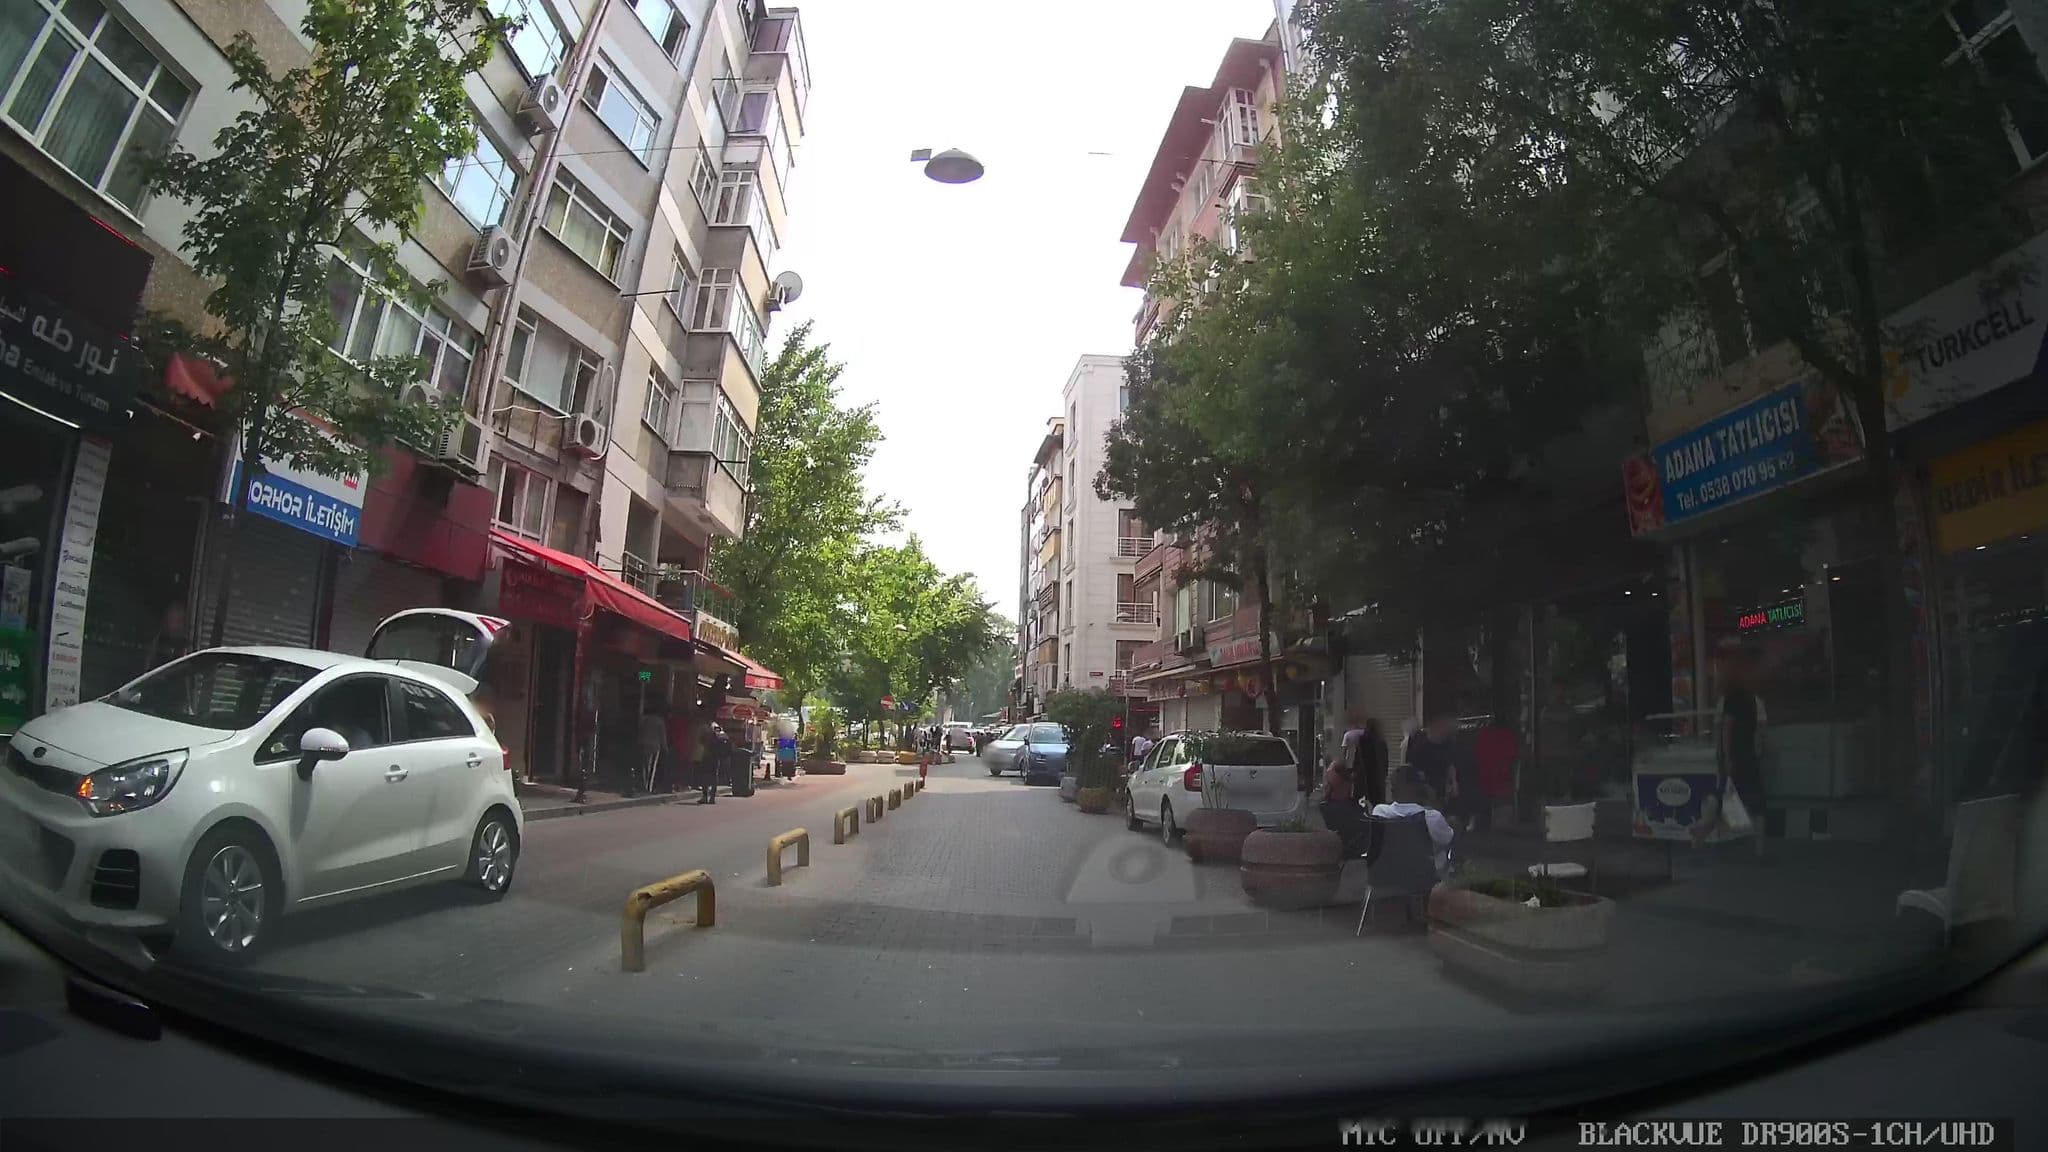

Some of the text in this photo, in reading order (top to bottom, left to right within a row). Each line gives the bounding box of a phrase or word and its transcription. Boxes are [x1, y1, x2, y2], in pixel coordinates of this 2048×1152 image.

[32, 315, 73, 353] طه
[1918, 299, 2035, 373] TURKCELL
[1664, 397, 1800, 484] ADANA TATLICISI
[1676, 487, 1698, 511] Tel.
[1732, 463, 1757, 492] 070
[305, 494, 355, 537] İLETİŞİM
[1739, 611, 1767, 629] ADANA
